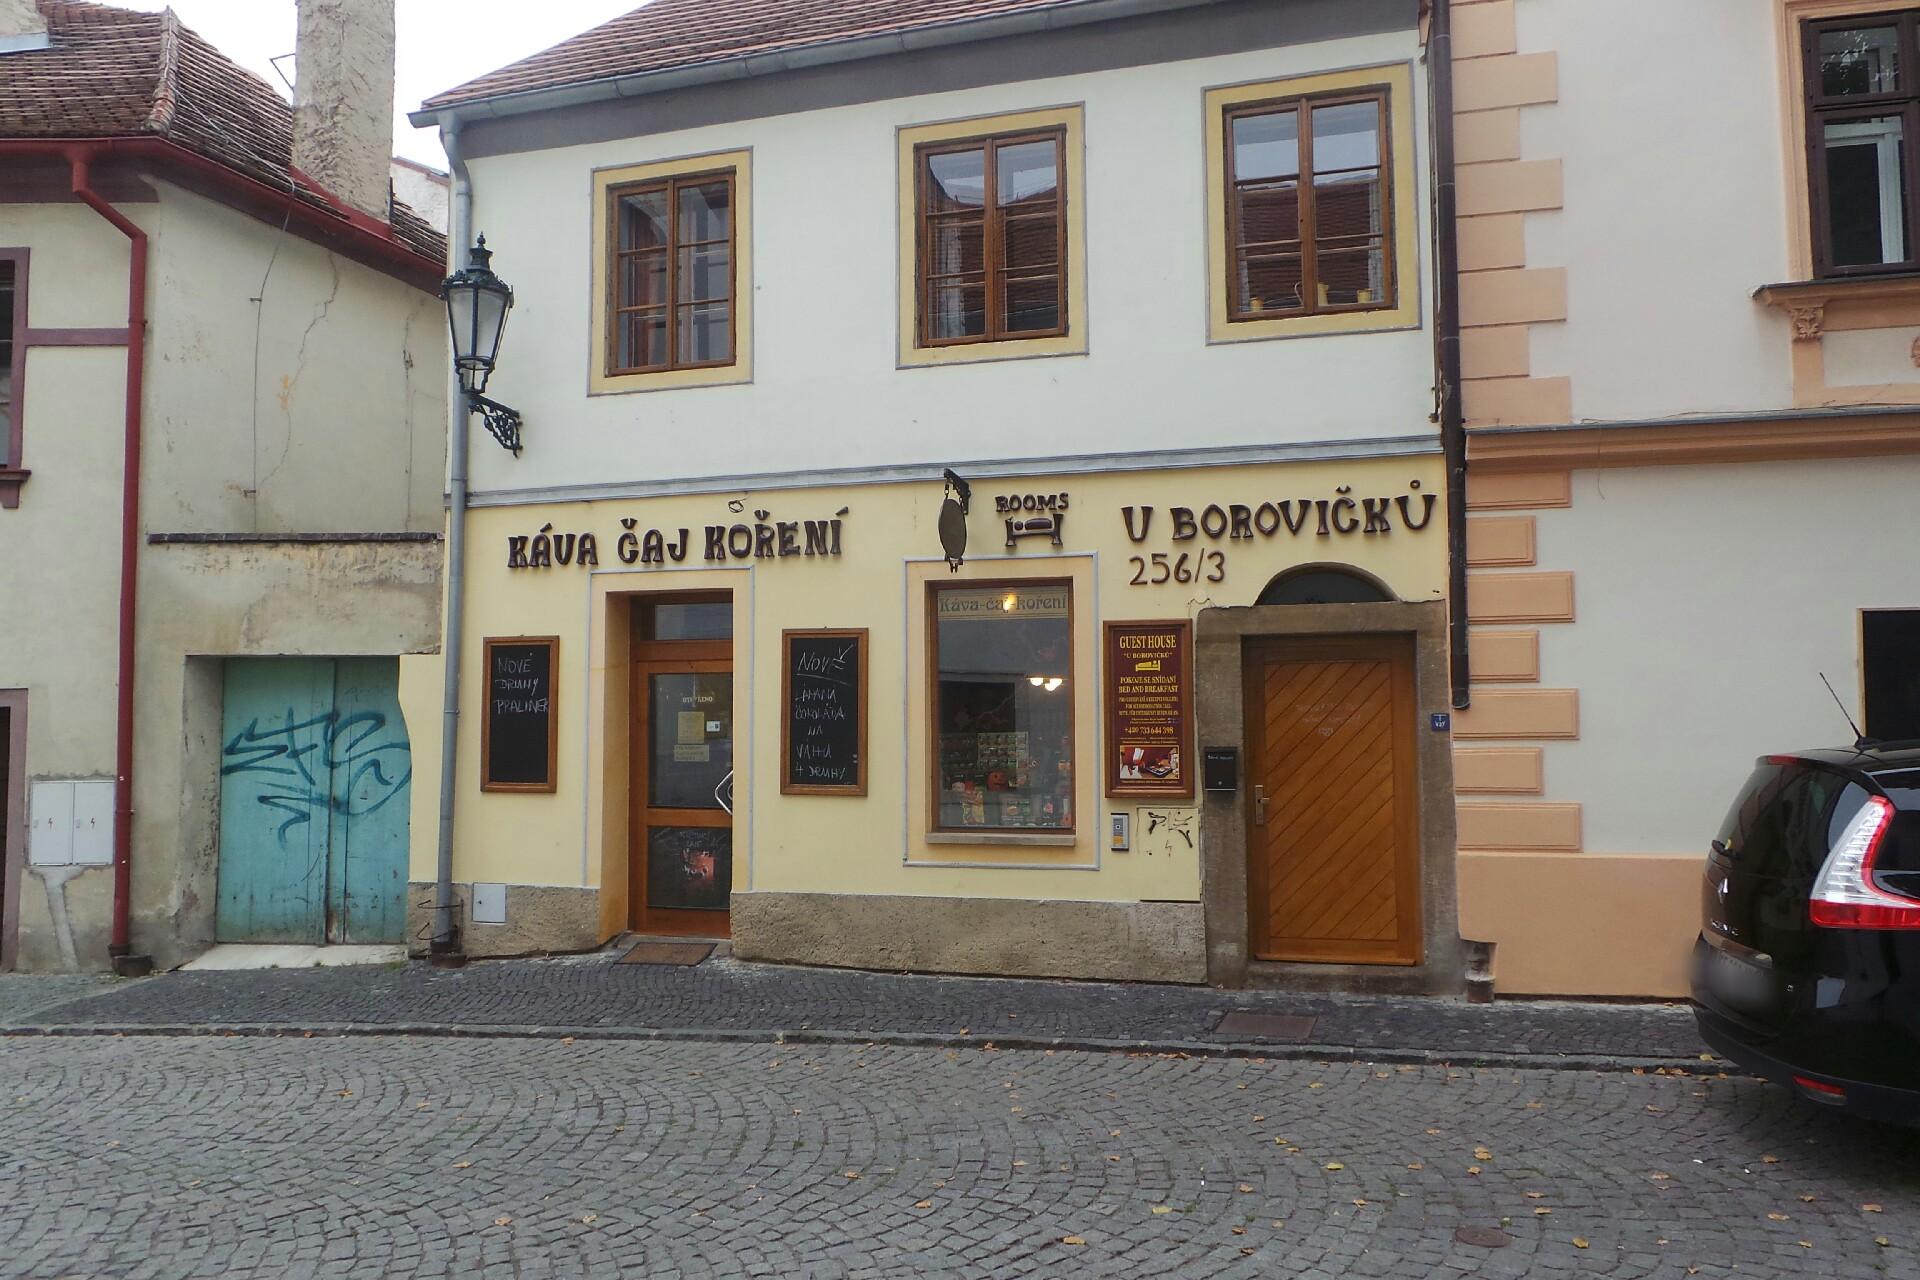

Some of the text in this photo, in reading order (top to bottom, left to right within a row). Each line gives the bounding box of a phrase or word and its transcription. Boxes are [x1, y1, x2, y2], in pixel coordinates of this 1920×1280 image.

[995, 493, 1069, 512] ROOMS
[1121, 480, 1438, 543] U BOROVIČKŮ
[507, 505, 849, 568] KÁVA ČAJ KOŘENÍ
[1128, 547, 1226, 586] 256/3
[1119, 634, 1177, 649] GUEST HOUSE
[1118, 685, 1178, 693] BED AND BREAKFAST
